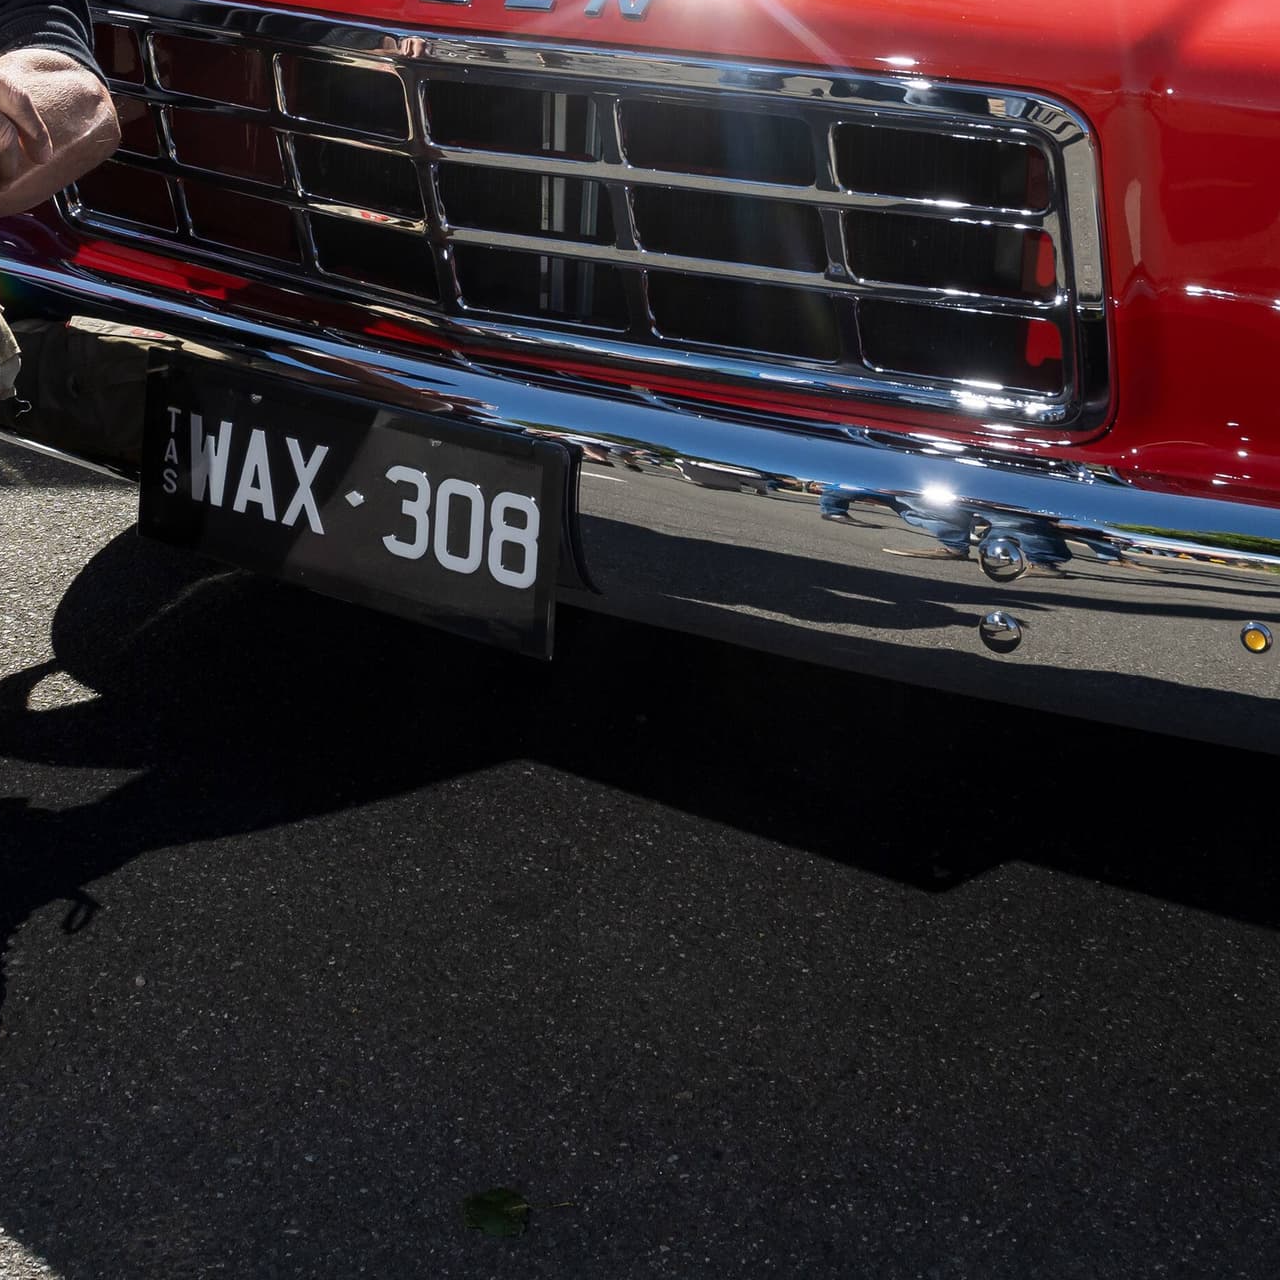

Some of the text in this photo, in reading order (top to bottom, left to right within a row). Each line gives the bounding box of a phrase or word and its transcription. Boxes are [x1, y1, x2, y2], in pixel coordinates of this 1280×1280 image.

[161, 406, 182, 495] TAS
[190, 413, 541, 589] WAX 308
